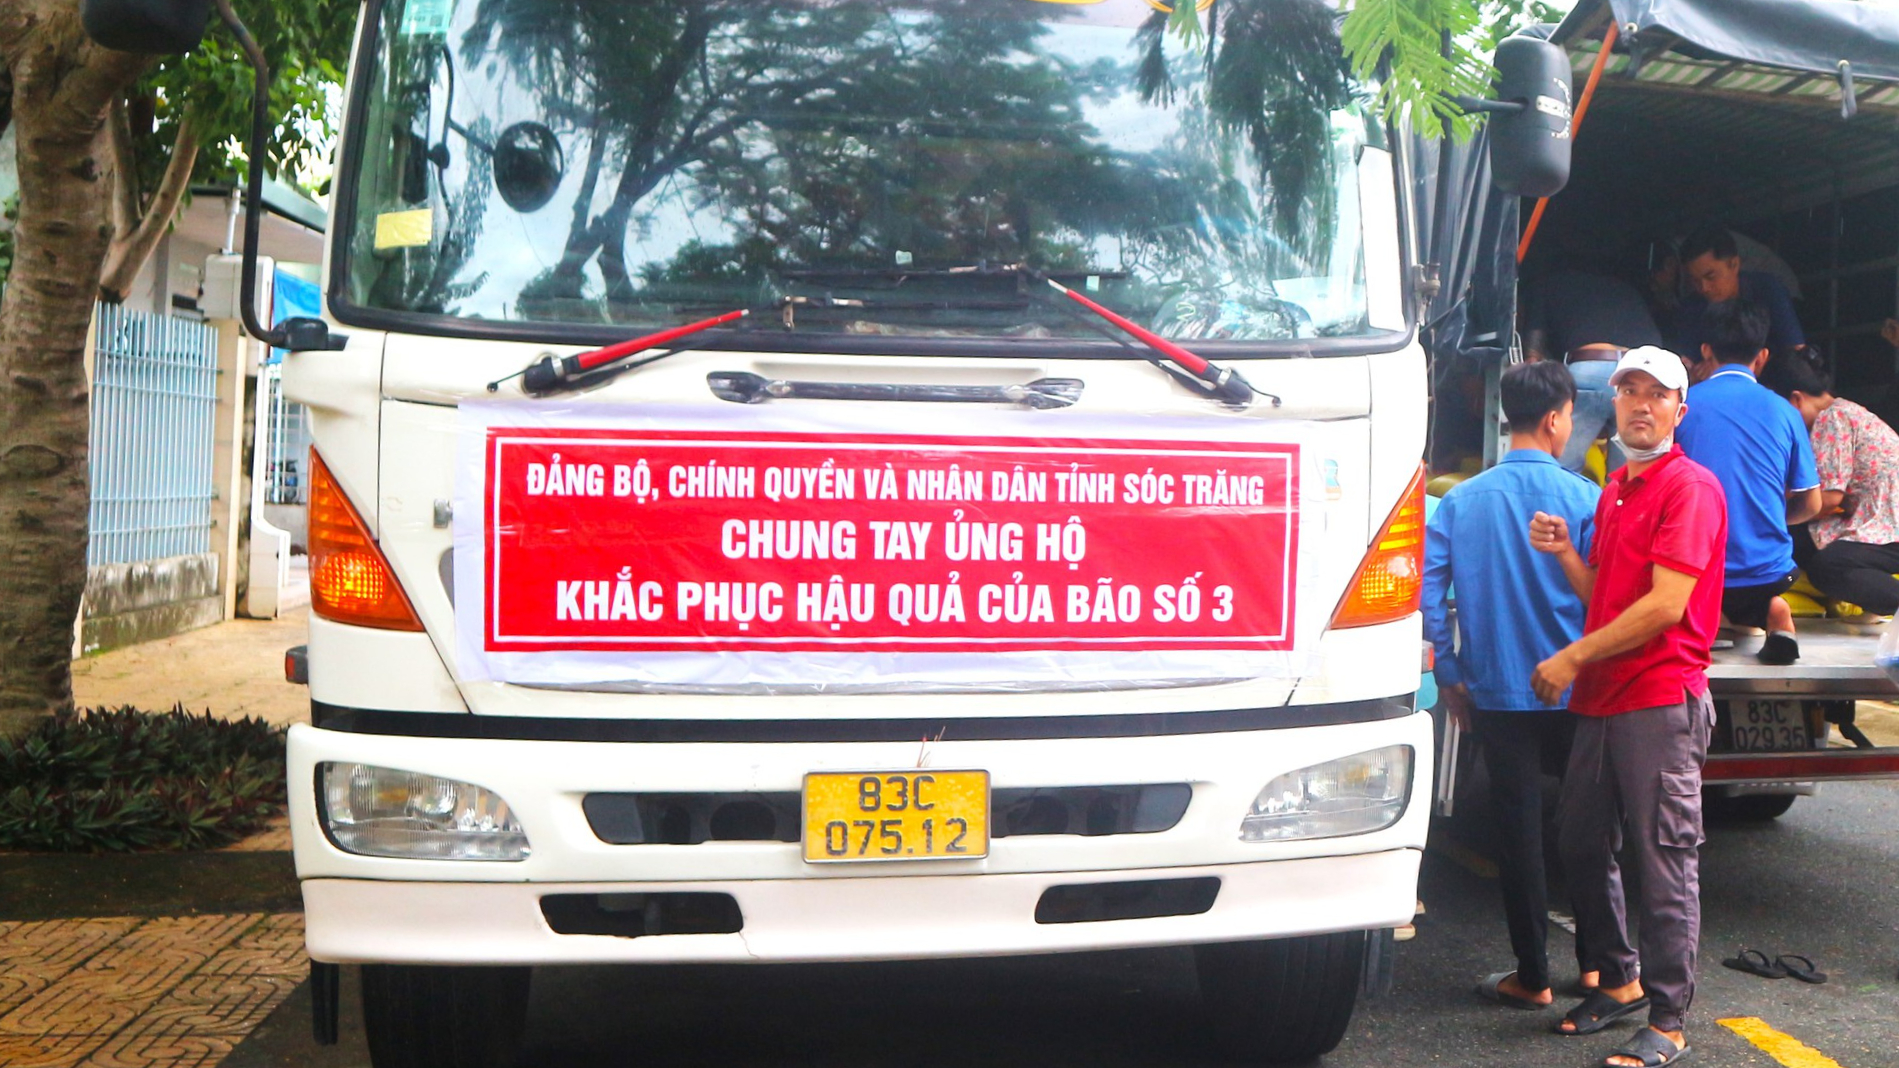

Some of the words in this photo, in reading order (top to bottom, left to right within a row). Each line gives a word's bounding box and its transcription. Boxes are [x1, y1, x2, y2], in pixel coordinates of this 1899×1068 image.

[526, 453, 605, 497] ĐẢNG
[614, 459, 659, 503] BỘ,
[668, 459, 755, 499] CHÍNH
[764, 457, 855, 500] QUYỀN
[864, 462, 899, 500] VÀ
[907, 463, 984, 502] NHÂN
[992, 464, 1047, 503] DÂN
[1055, 462, 1116, 504] TỈNH
[1123, 467, 1175, 505] SÓC
[1182, 469, 1265, 506] TRĂNG
[721, 518, 857, 560] CHUNG
[868, 520, 933, 561] TAY
[944, 508, 1023, 562] ỦNG
[1036, 515, 1087, 571] HỘ
[556, 566, 664, 622] KHẮC
[677, 580, 783, 631] PHỤC
[796, 574, 875, 631] HẬU
[888, 570, 967, 626] QUẢ
[978, 571, 1055, 623] CỦA
[1066, 576, 1142, 624] BÃO
[1152, 571, 1204, 623] SỐ
[1211, 584, 1234, 622] 3
[1748, 700, 1787, 724] 83C
[858, 775, 935, 812] 83C
[825, 817, 968, 856] 075.12
